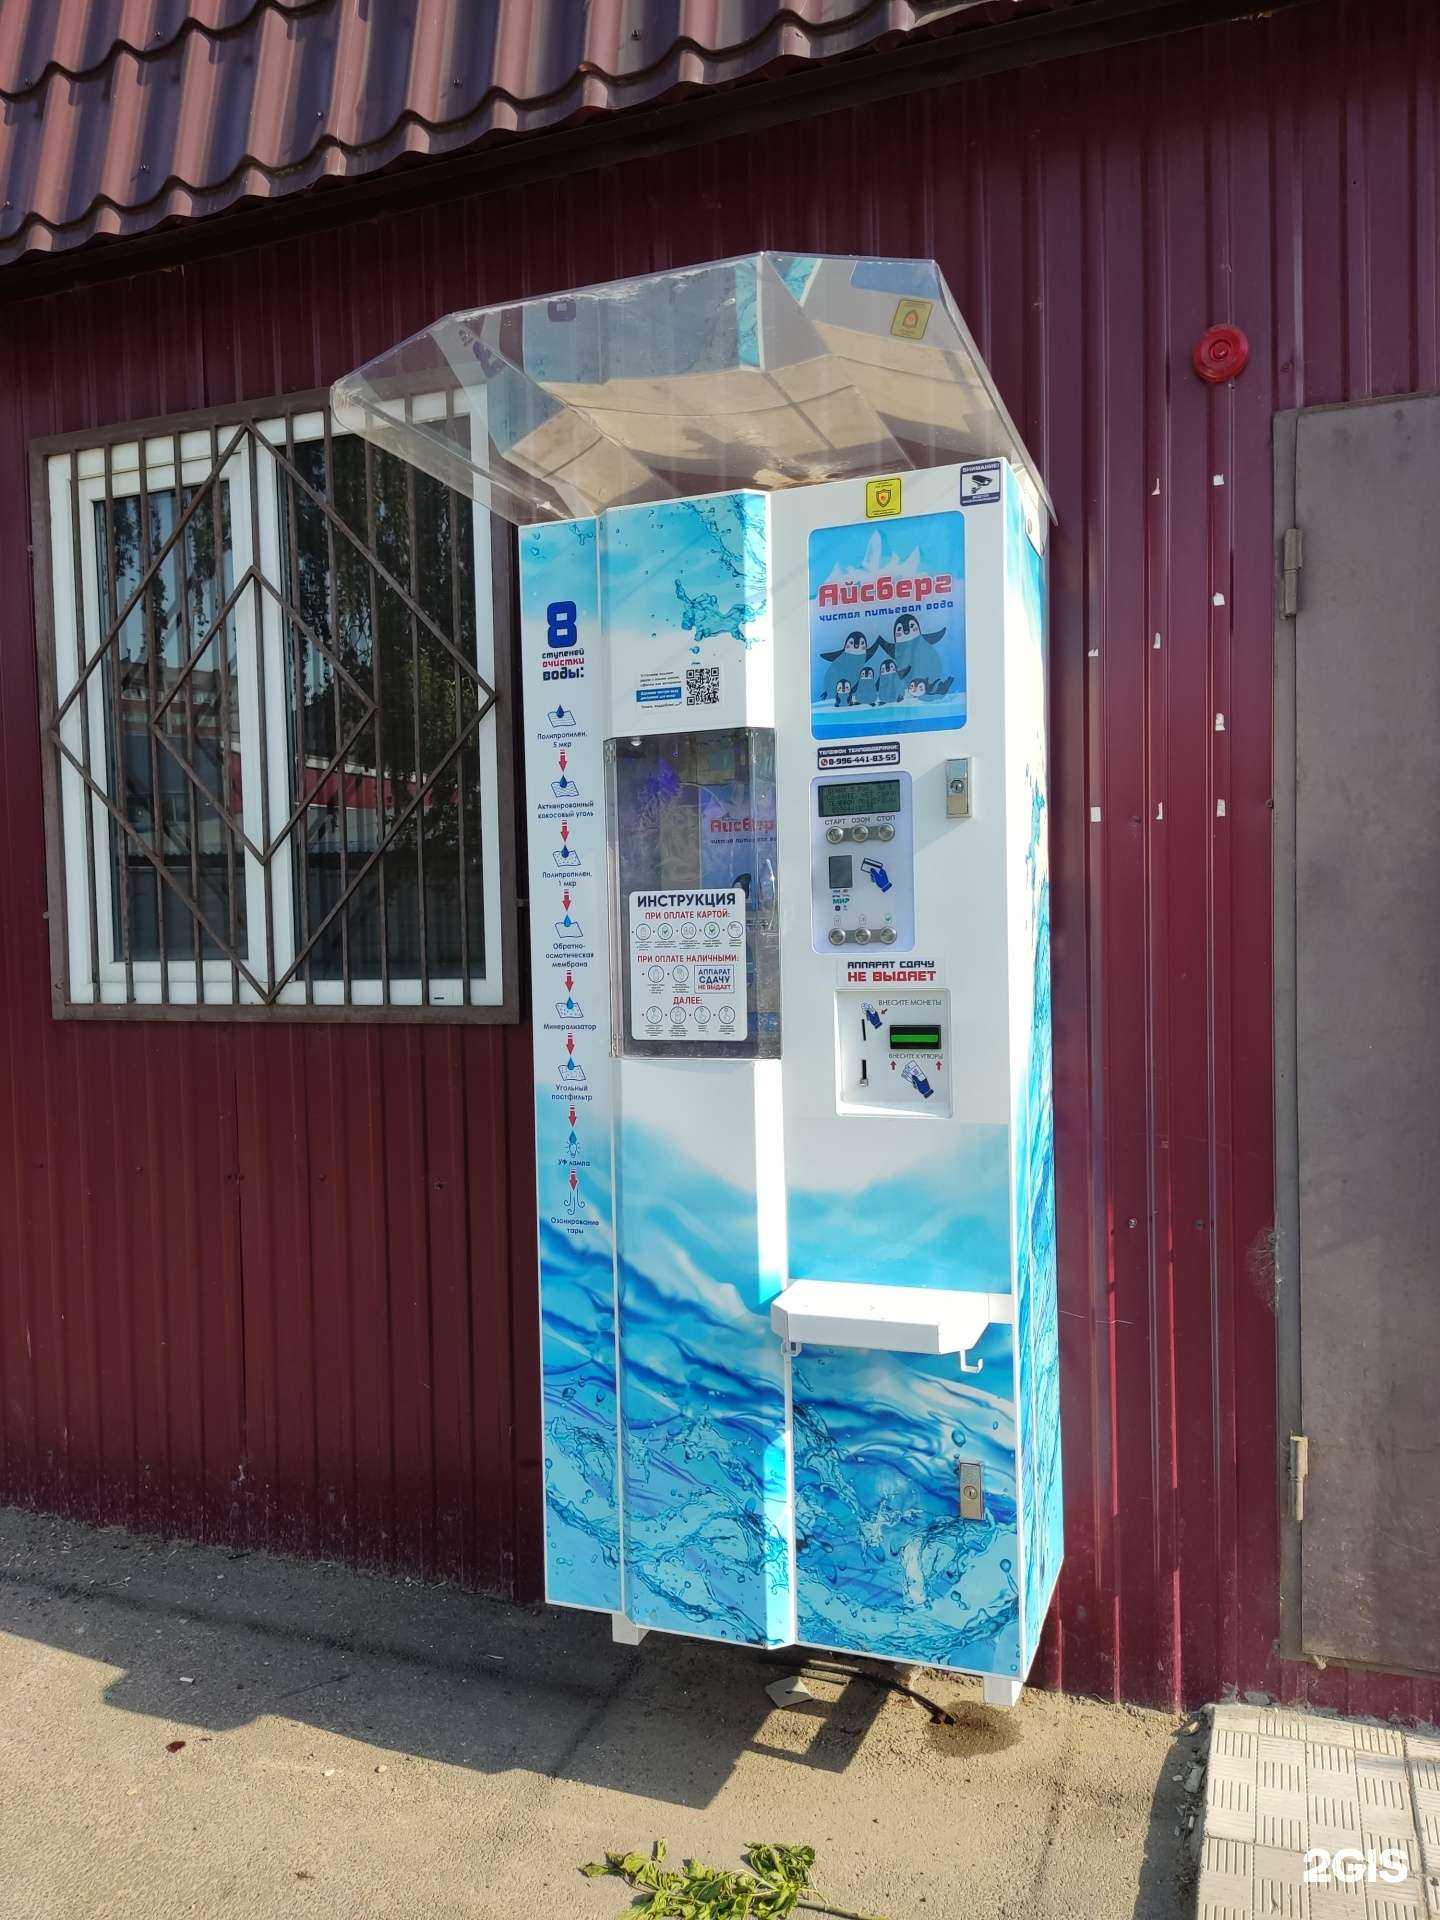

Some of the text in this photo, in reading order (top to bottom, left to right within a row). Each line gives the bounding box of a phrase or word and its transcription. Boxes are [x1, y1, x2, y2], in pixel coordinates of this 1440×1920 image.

[818, 573, 952, 608] Айсберг
[819, 600, 954, 622] чистая питьевая вода
[547, 601, 577, 648] 8
[542, 648, 585, 660] ступеней
[542, 658, 585, 668] очистки
[543, 667, 585, 681] воды:
[824, 814, 896, 826] СТАРТ ОЗОН СТОП
[637, 893, 736, 908] ИНСТРУКЦИЯ
[645, 908, 731, 920] ПРИ ОПЛАТЕ КАРТОЙ:
[553, 943, 586, 951] Обратно-
[637, 955, 653, 963] ПРИ
[654, 955, 684, 963] ОПЛАТЕ
[552, 961, 588, 969] мембрана
[848, 960, 935, 970] АППАРАТ СДАЧУ
[698, 968, 731, 976] АППАРАТ
[848, 970, 937, 982] НЕ ВЫДАЕТ
[698, 976, 731, 985] СДАЧУ
[672, 996, 703, 1006] ДАЛЕЕ:
[543, 1023, 597, 1032] Минерализатор
[551, 1093, 593, 1103] постфильтр
